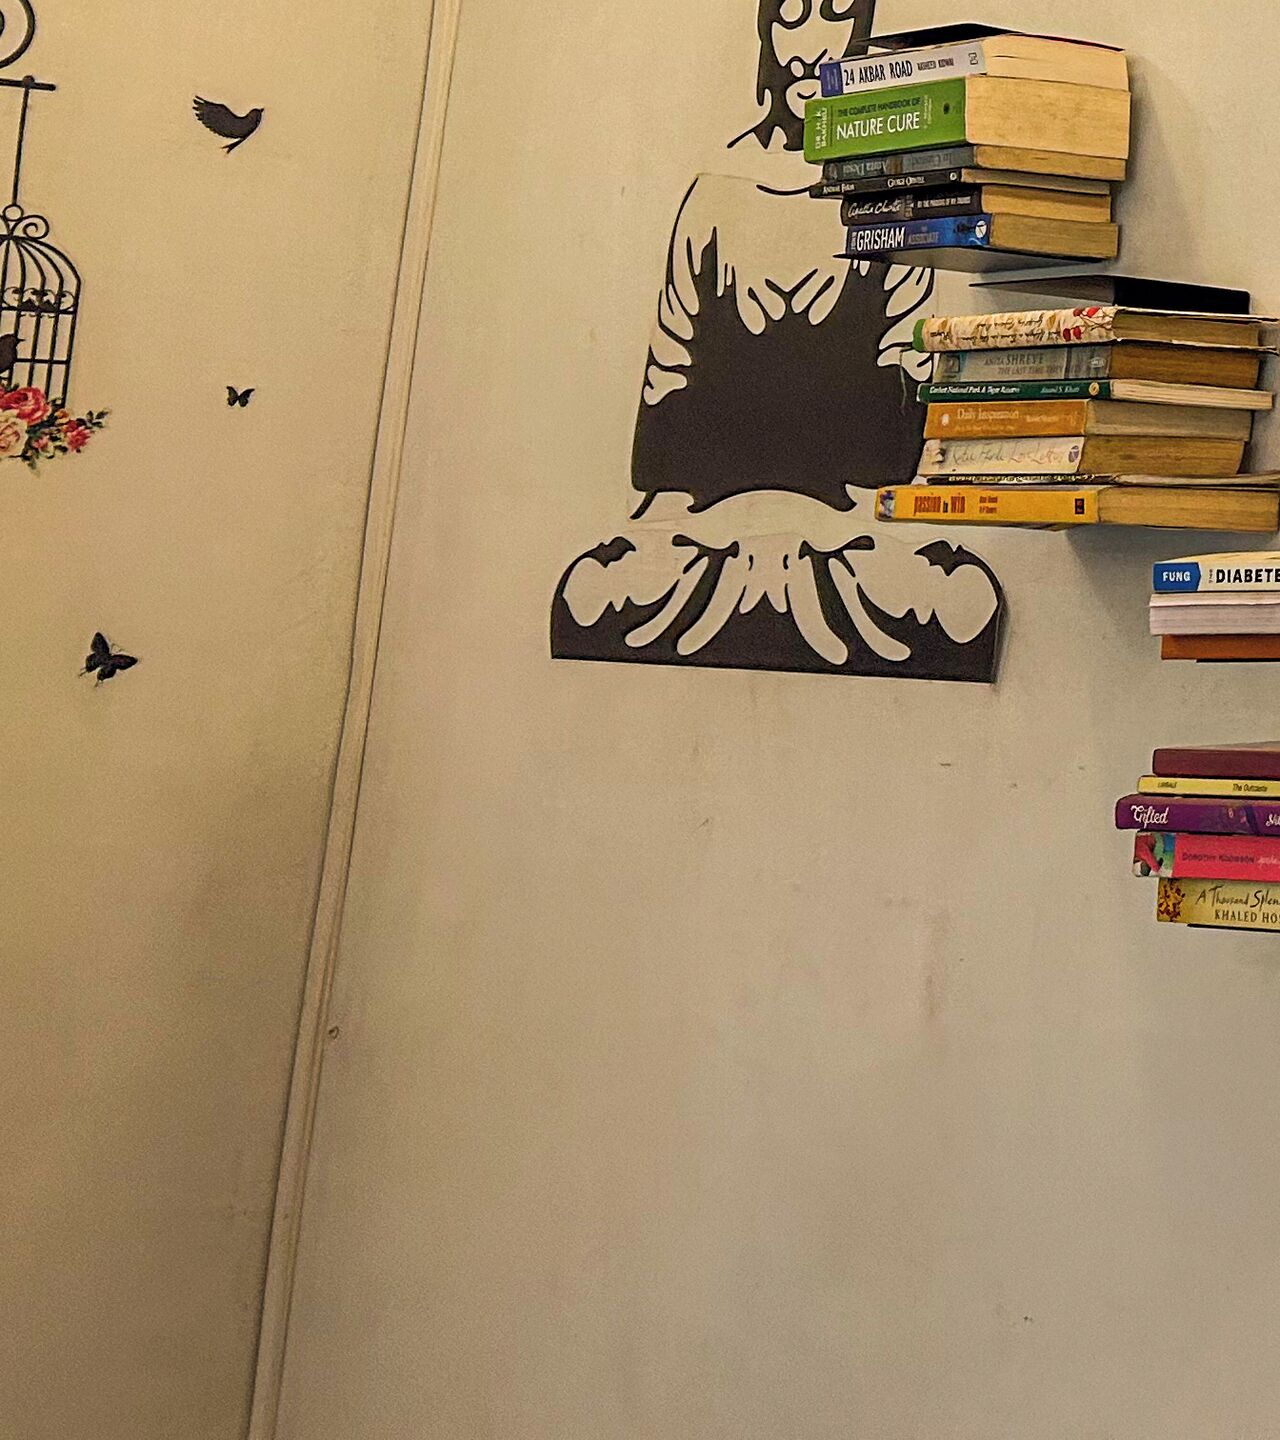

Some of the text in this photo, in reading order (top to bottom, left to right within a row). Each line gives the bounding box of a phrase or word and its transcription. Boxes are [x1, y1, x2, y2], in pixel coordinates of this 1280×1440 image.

[844, 69, 855, 86] 24
[859, 64, 885, 84] AKBAR
[890, 60, 913, 78] ROAD
[837, 117, 884, 140] NATURE
[887, 112, 920, 132] CURE
[857, 226, 905, 251] GRISHAM
[1006, 353, 1044, 365] SHREVE
[1162, 571, 1191, 582] FUNG
[1130, 805, 1168, 828] Gifted
[1196, 887, 1206, 900] A
[1208, 885, 1248, 907] Thousand
[1215, 909, 1257, 923] KHALED
